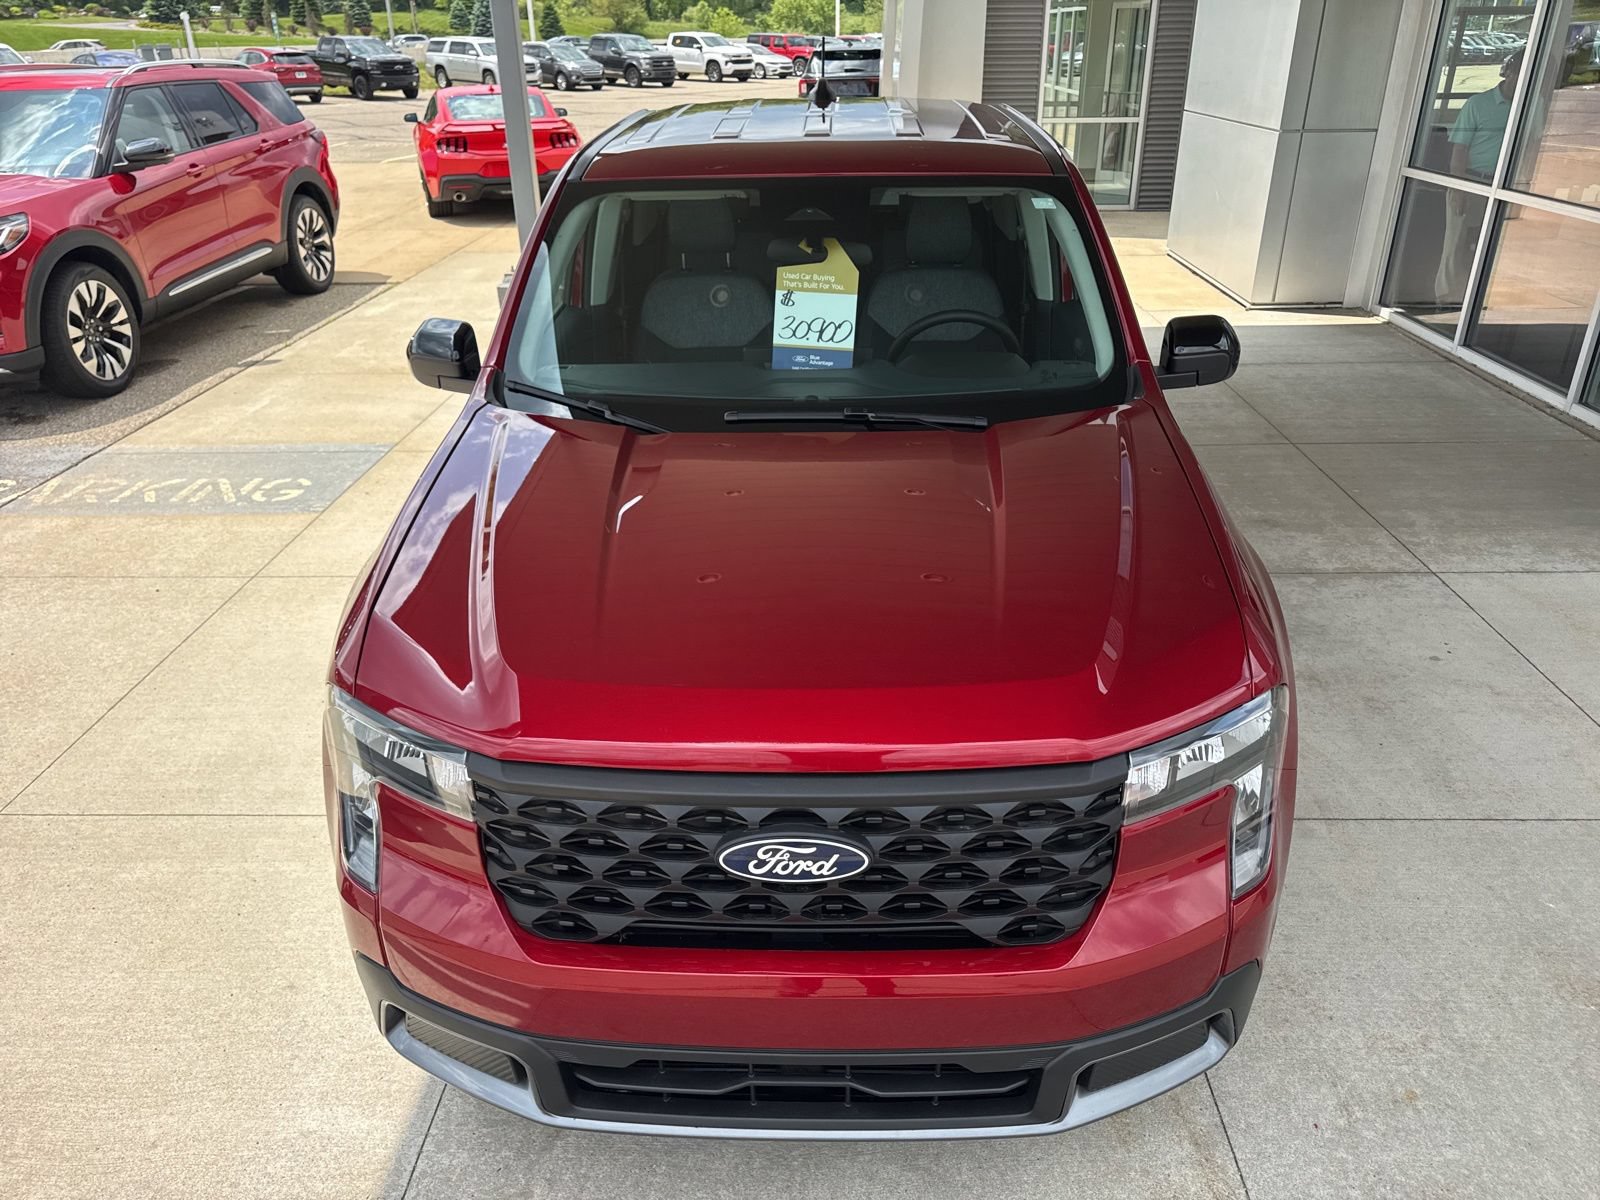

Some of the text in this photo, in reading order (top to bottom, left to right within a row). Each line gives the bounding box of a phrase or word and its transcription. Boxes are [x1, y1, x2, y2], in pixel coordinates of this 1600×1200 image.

[783, 280, 802, 288] That's
[804, 281, 818, 289] Built
[813, 274, 835, 283] Buying
[780, 289, 796, 307] $
[748, 845, 840, 876] Ford
